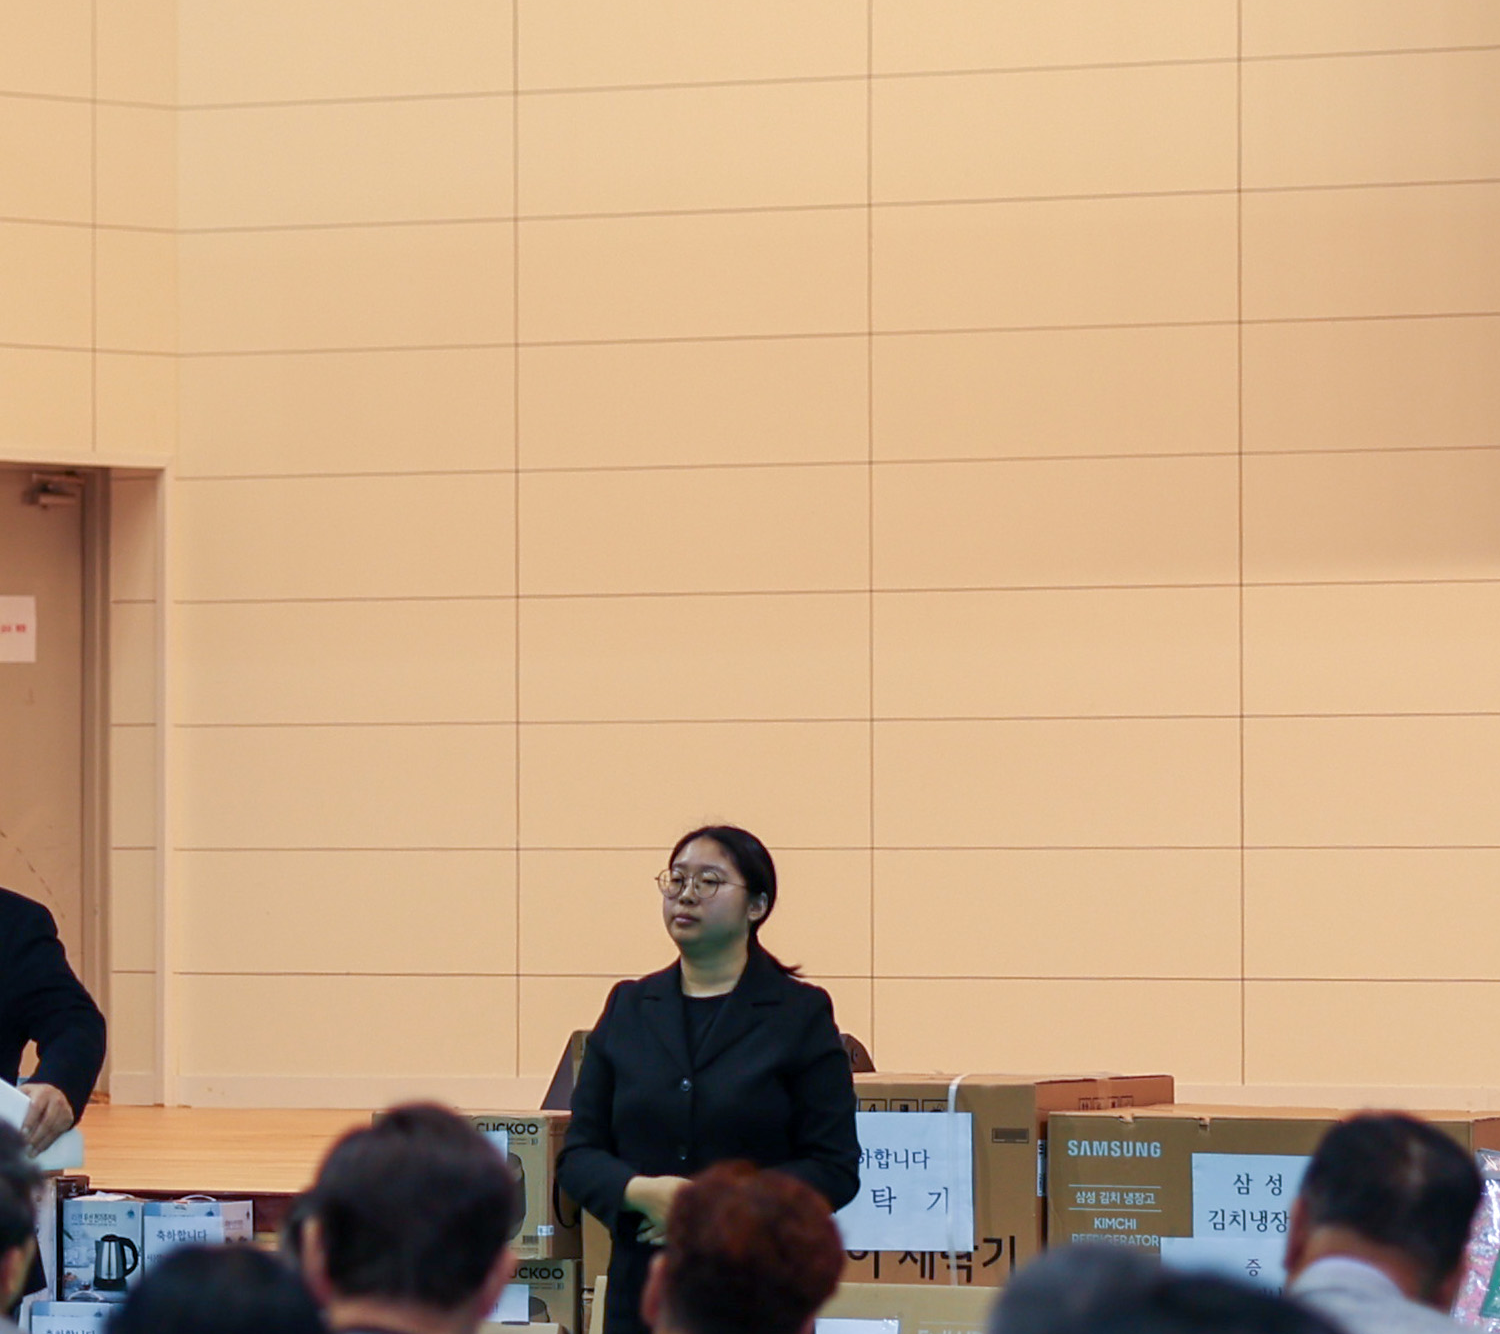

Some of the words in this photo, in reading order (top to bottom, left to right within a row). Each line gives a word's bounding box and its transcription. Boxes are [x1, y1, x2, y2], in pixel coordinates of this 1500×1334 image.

[1067, 1139, 1162, 1158] SAMSUNG
[857, 1148, 931, 1170] 하합니다
[1075, 1191, 1097, 1205] 삼성
[1099, 1191, 1121, 1205] 김치
[1123, 1192, 1156, 1205] 냉장고
[1093, 1217, 1138, 1230] KIMCHI
[1208, 1208, 1289, 1234] 김치냉장
[156, 1229, 208, 1242] 축하합니다
[507, 1267, 565, 1280] UCKOO
[1245, 1258, 1262, 1278] 증
